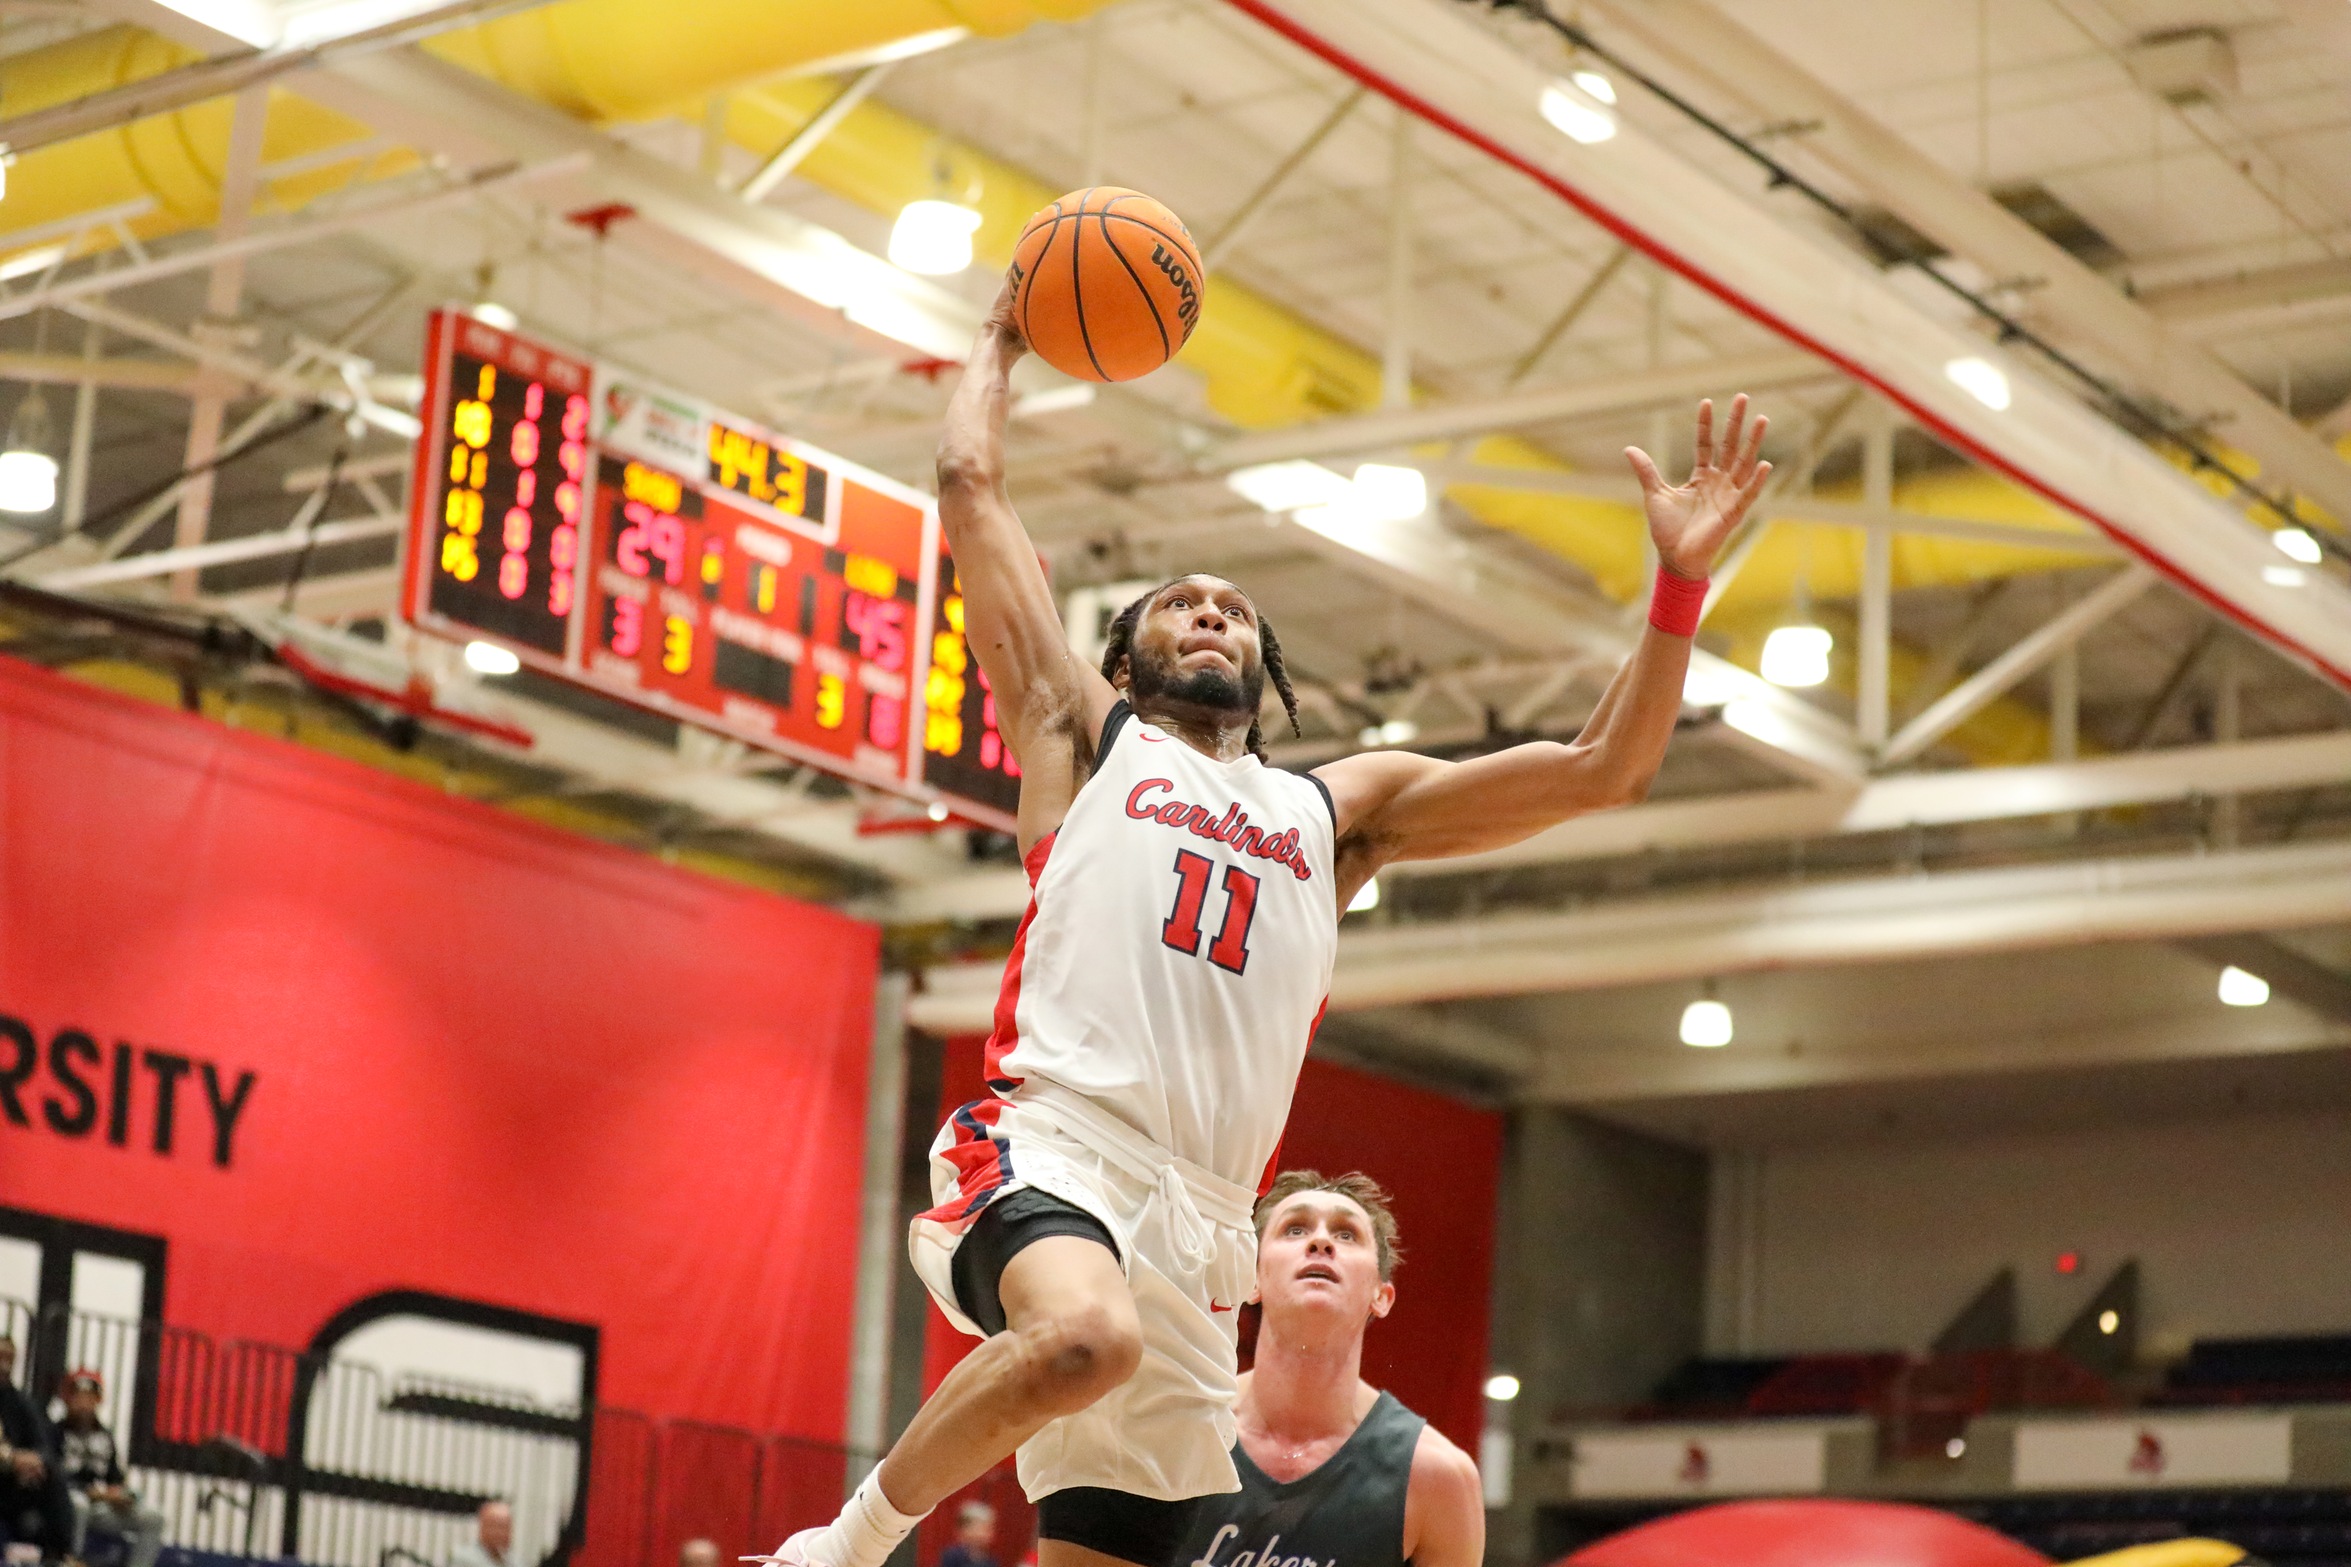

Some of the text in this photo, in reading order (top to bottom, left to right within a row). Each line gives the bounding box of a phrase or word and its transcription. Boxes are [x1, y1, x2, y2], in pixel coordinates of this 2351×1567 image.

[1151, 243, 1199, 350] ilson
[617, 500, 686, 585] 29
[611, 594, 643, 657] 3
[662, 613, 693, 675] 3
[845, 590, 906, 673] 45
[816, 673, 845, 729] 3
[1126, 778, 1312, 881] Cardinals
[1161, 847, 1261, 976] 11
